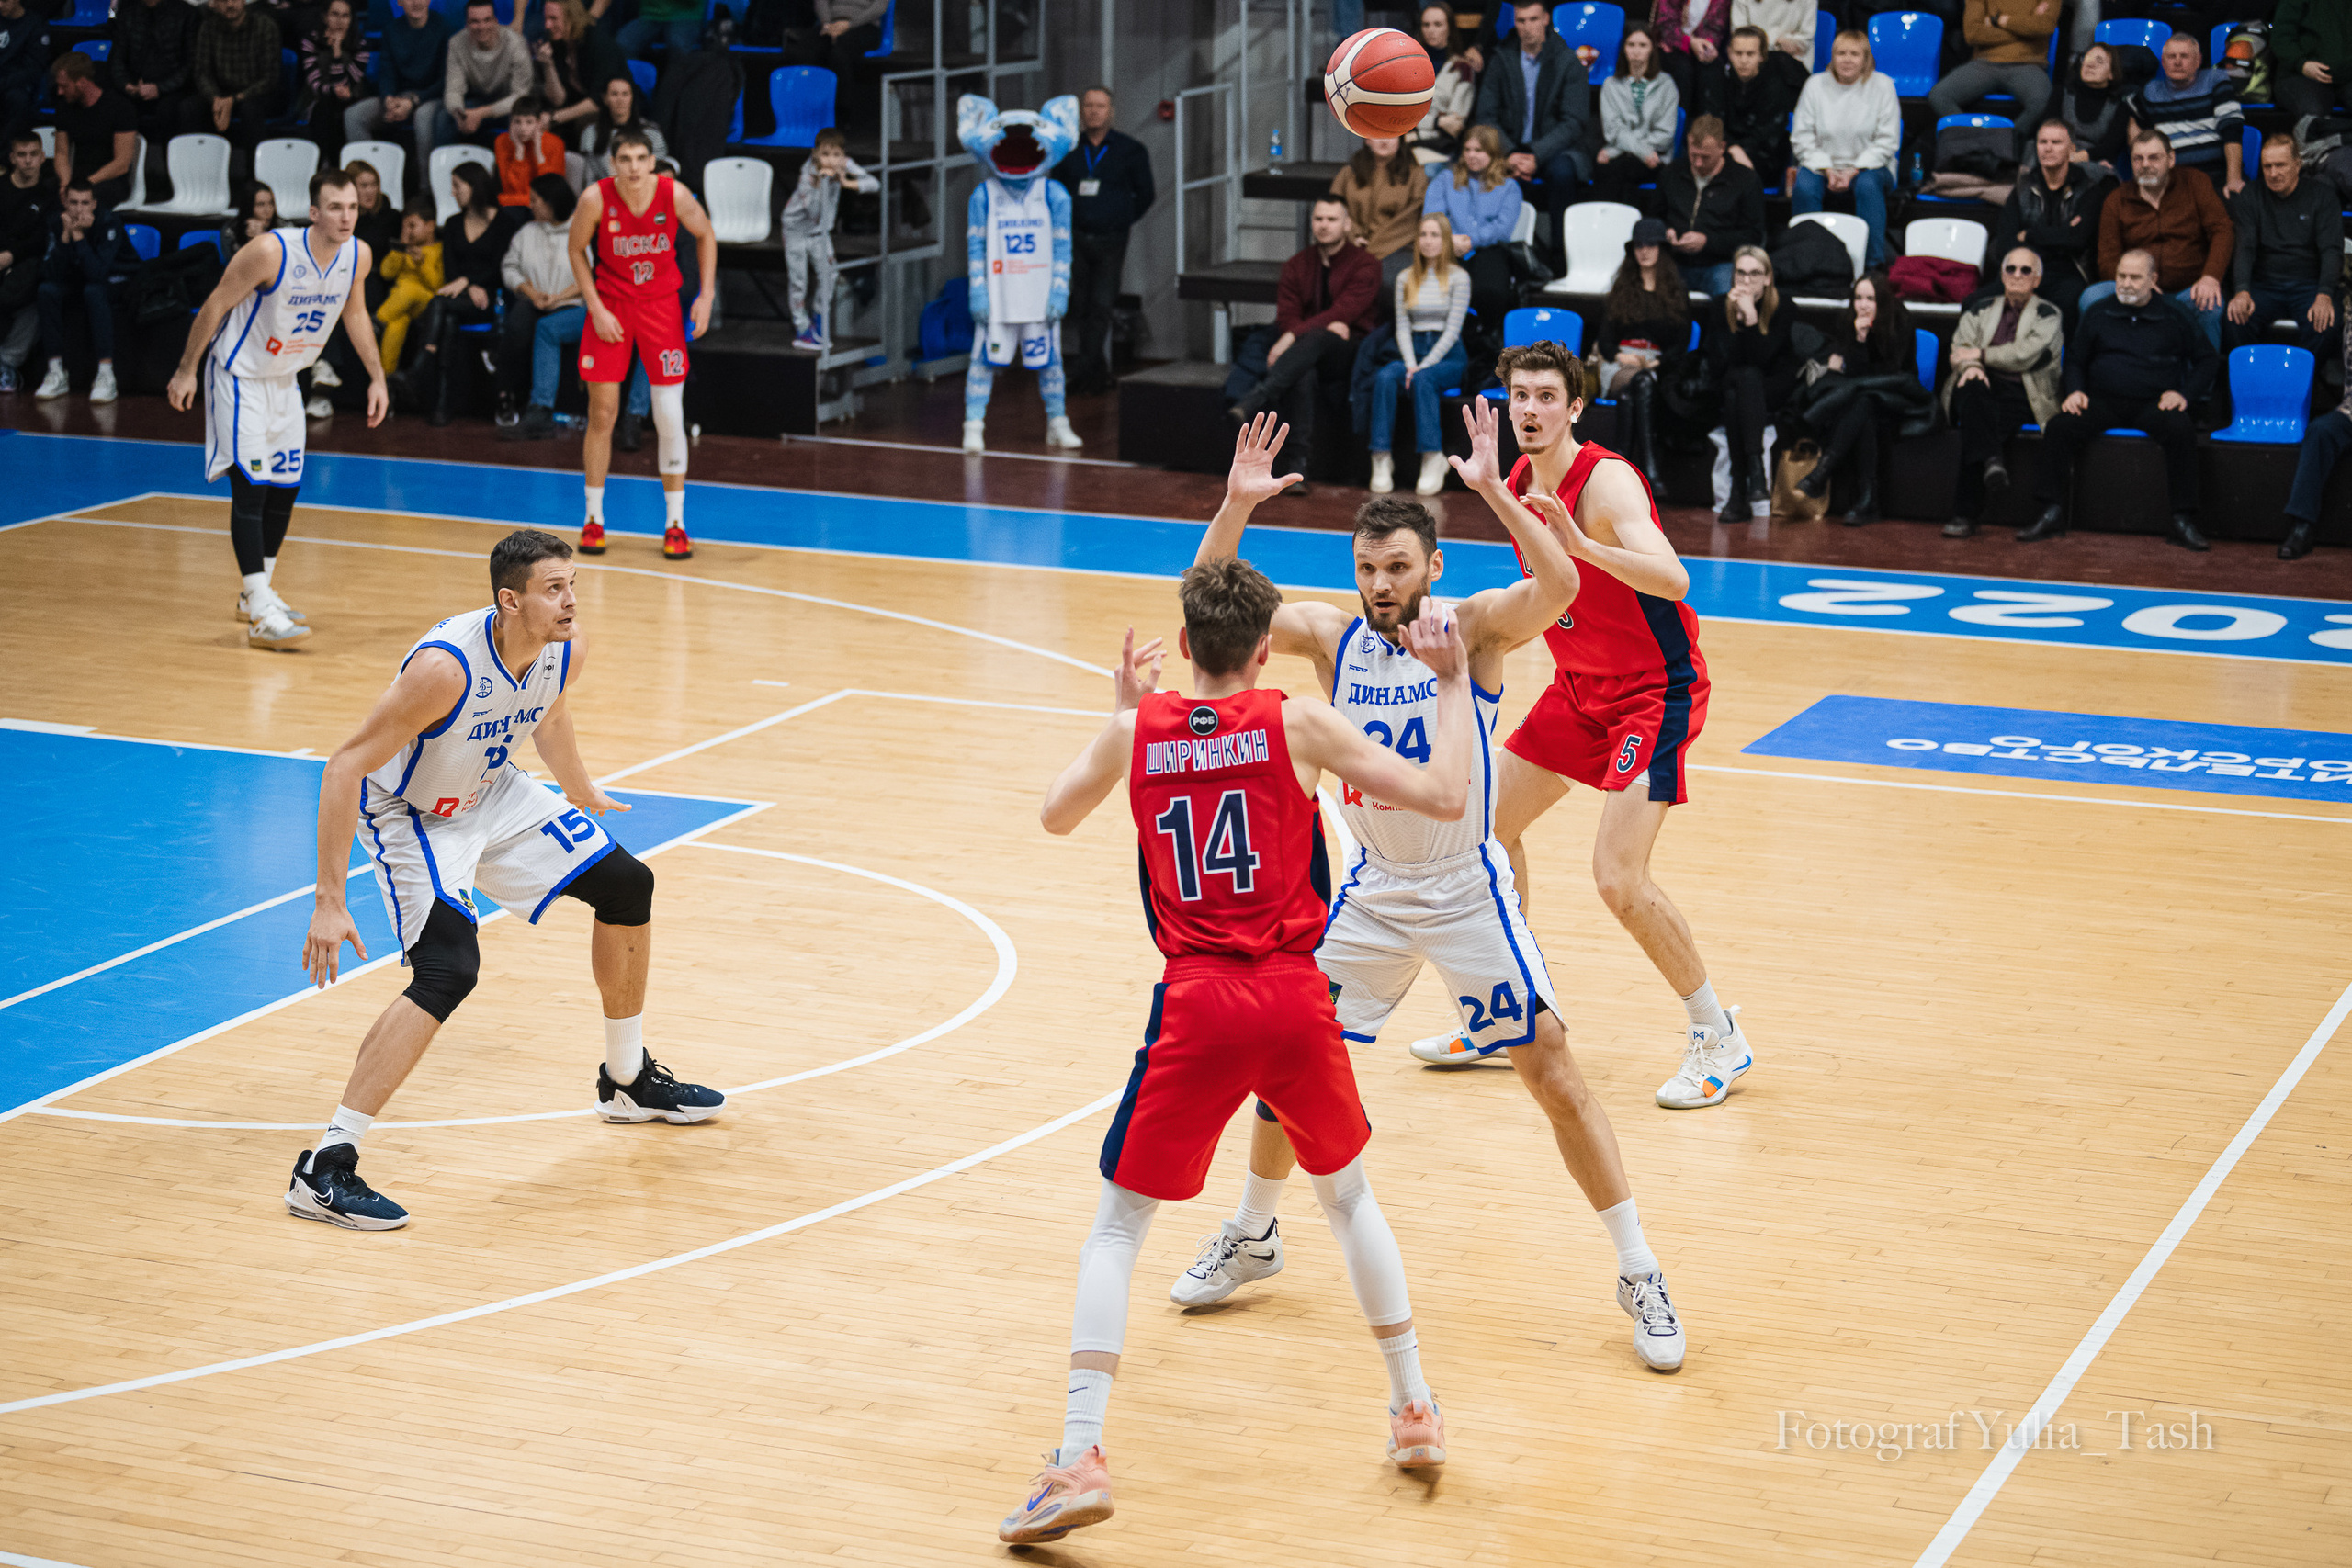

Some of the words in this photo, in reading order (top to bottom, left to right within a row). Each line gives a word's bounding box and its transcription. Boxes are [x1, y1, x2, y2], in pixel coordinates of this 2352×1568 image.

[613, 232, 671, 258] ЦСКА
[1004, 233, 1035, 254] 125
[629, 261, 655, 285] 12
[291, 310, 326, 334] 25
[659, 349, 684, 377] 12
[271, 449, 300, 473] 25
[1193, 716, 1215, 726] РФБ
[1146, 729, 1269, 775] ШИРИНКИН
[1616, 734, 1643, 773] 5
[540, 808, 596, 854] 15
[1155, 789, 1261, 902] 14
[1459, 980, 1523, 1033] 24
